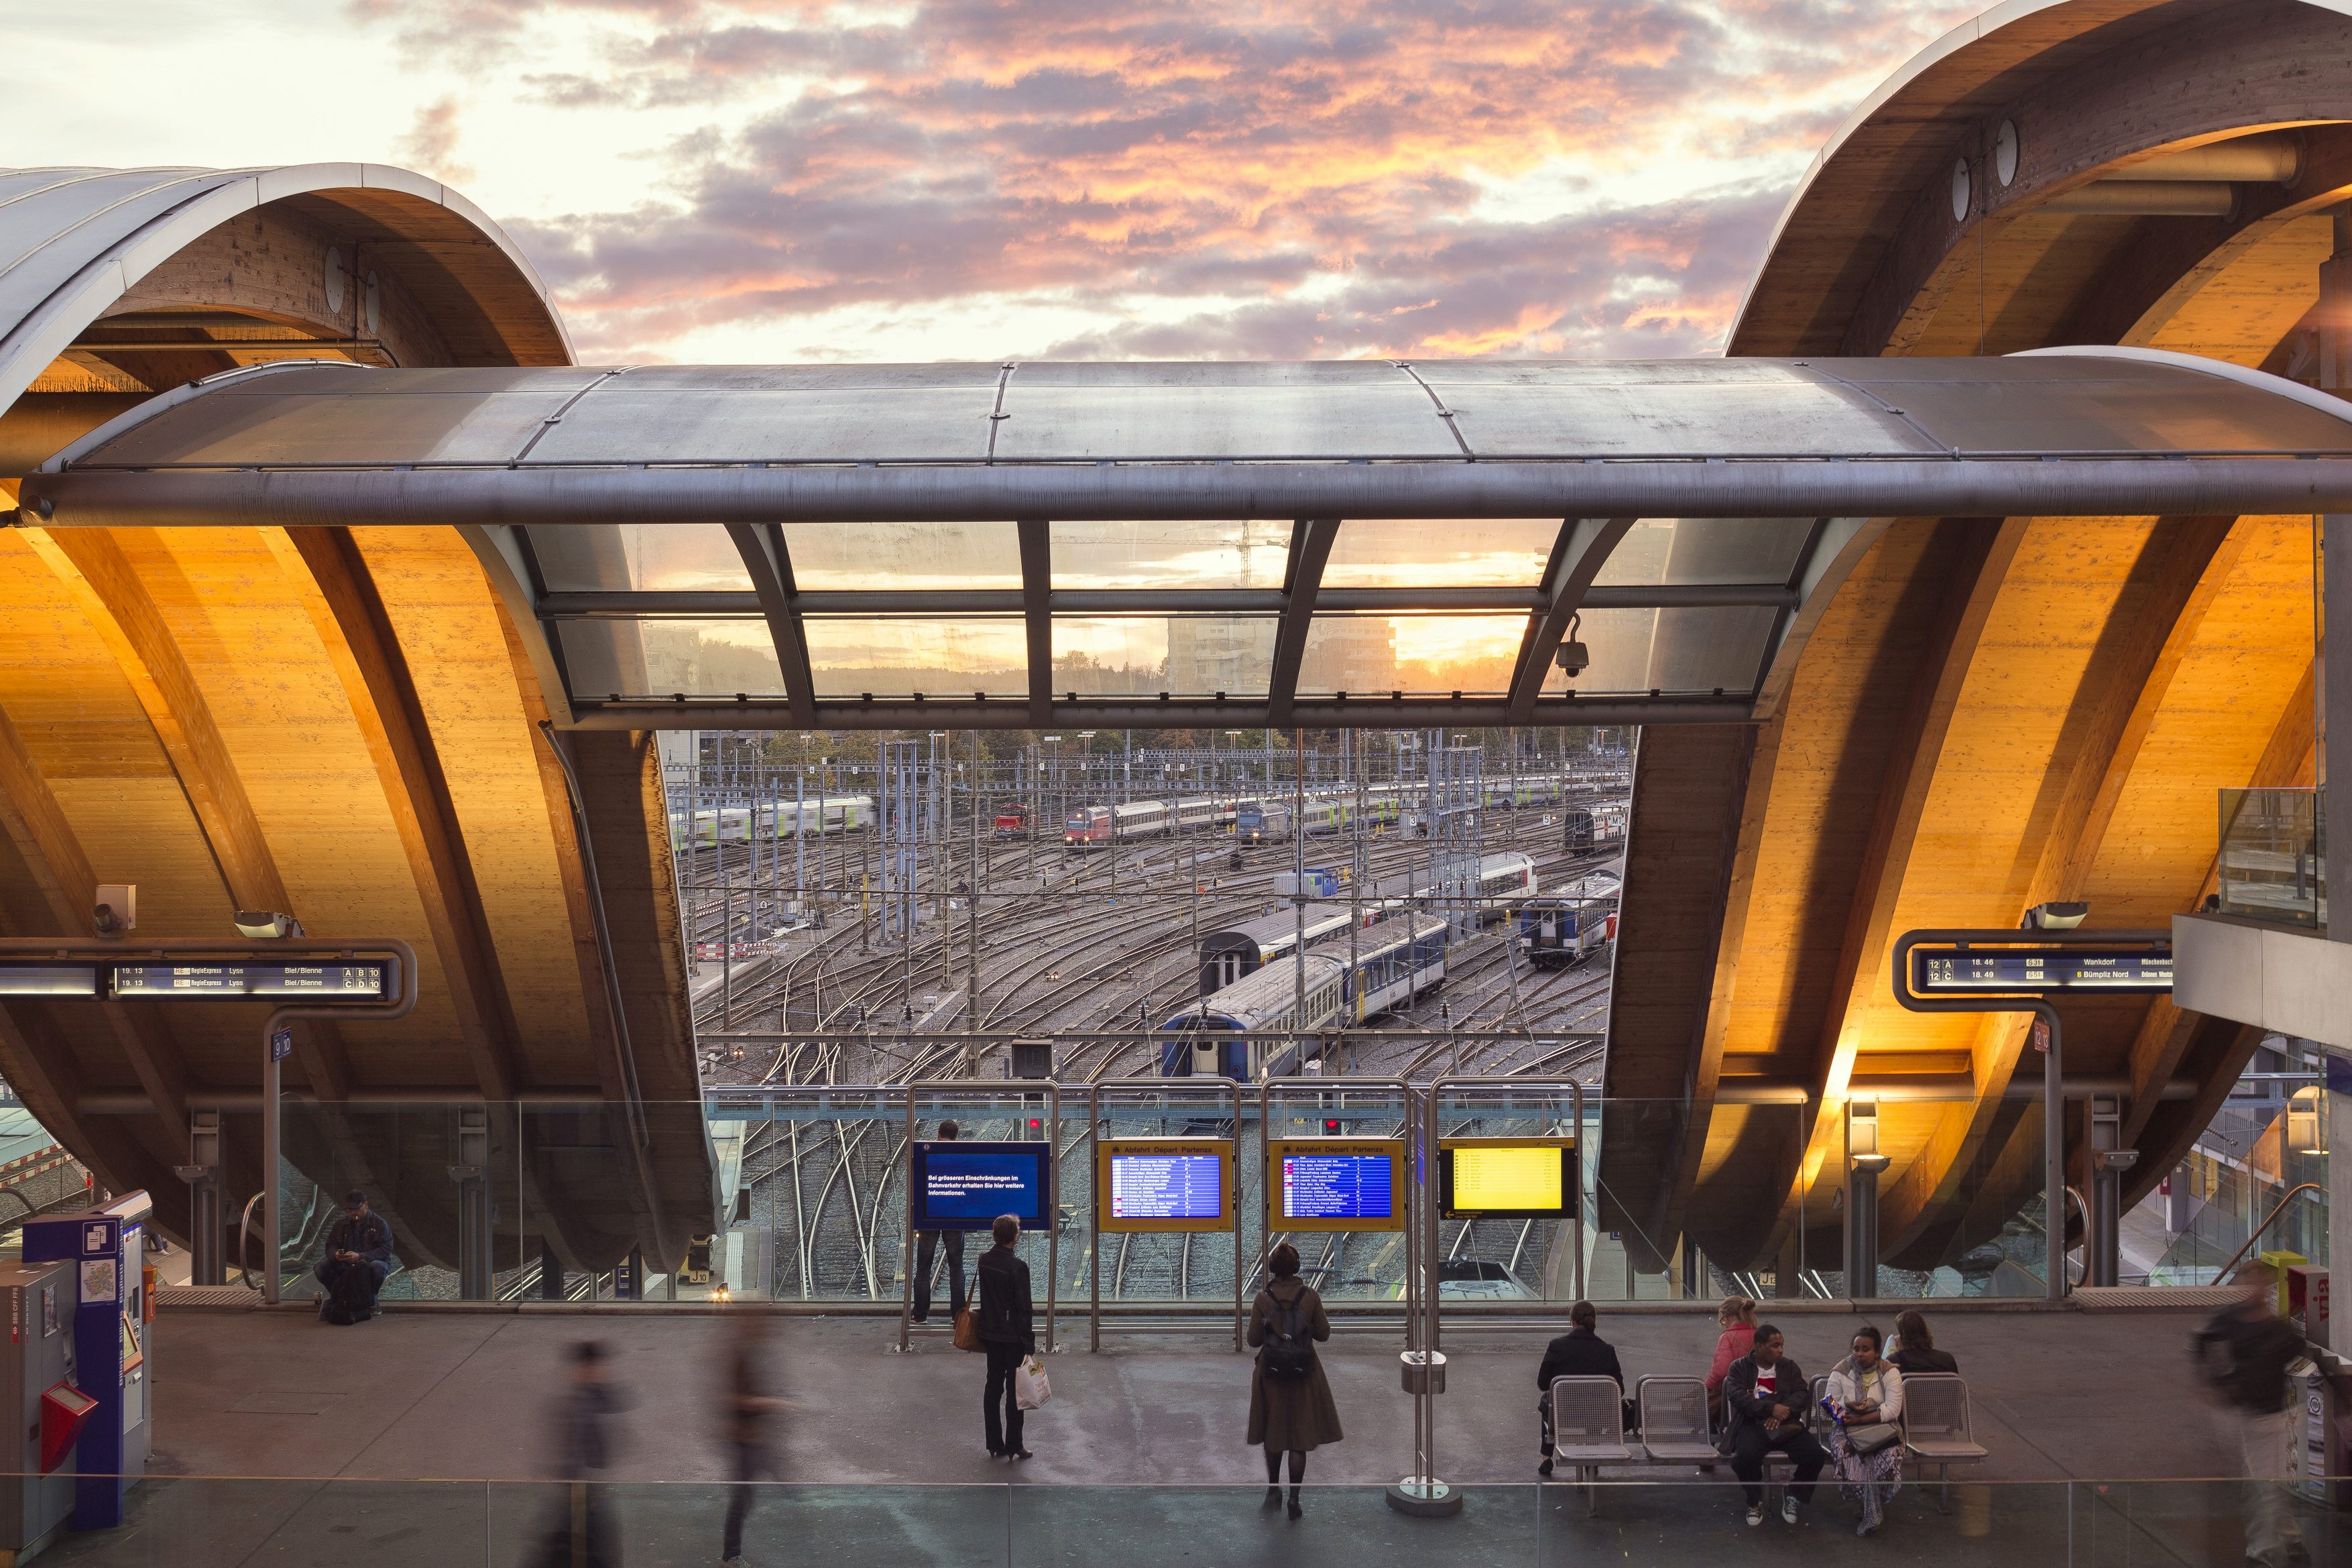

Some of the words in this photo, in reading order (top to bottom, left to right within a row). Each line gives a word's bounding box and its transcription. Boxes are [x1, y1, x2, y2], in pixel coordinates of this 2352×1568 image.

[1612, 817, 1621, 825] M1
[1930, 960, 1939, 969] 12
[1945, 961, 1951, 969] A
[2083, 971, 2111, 979] Bümpliz
[2036, 1030, 2041, 1045] 12
[2043, 1034, 2048, 1048] 13
[276, 1042, 280, 1056] 9
[284, 1037, 290, 1052] 10
[699, 1274, 707, 1282] 10
[2313, 1278, 2329, 1322] via
